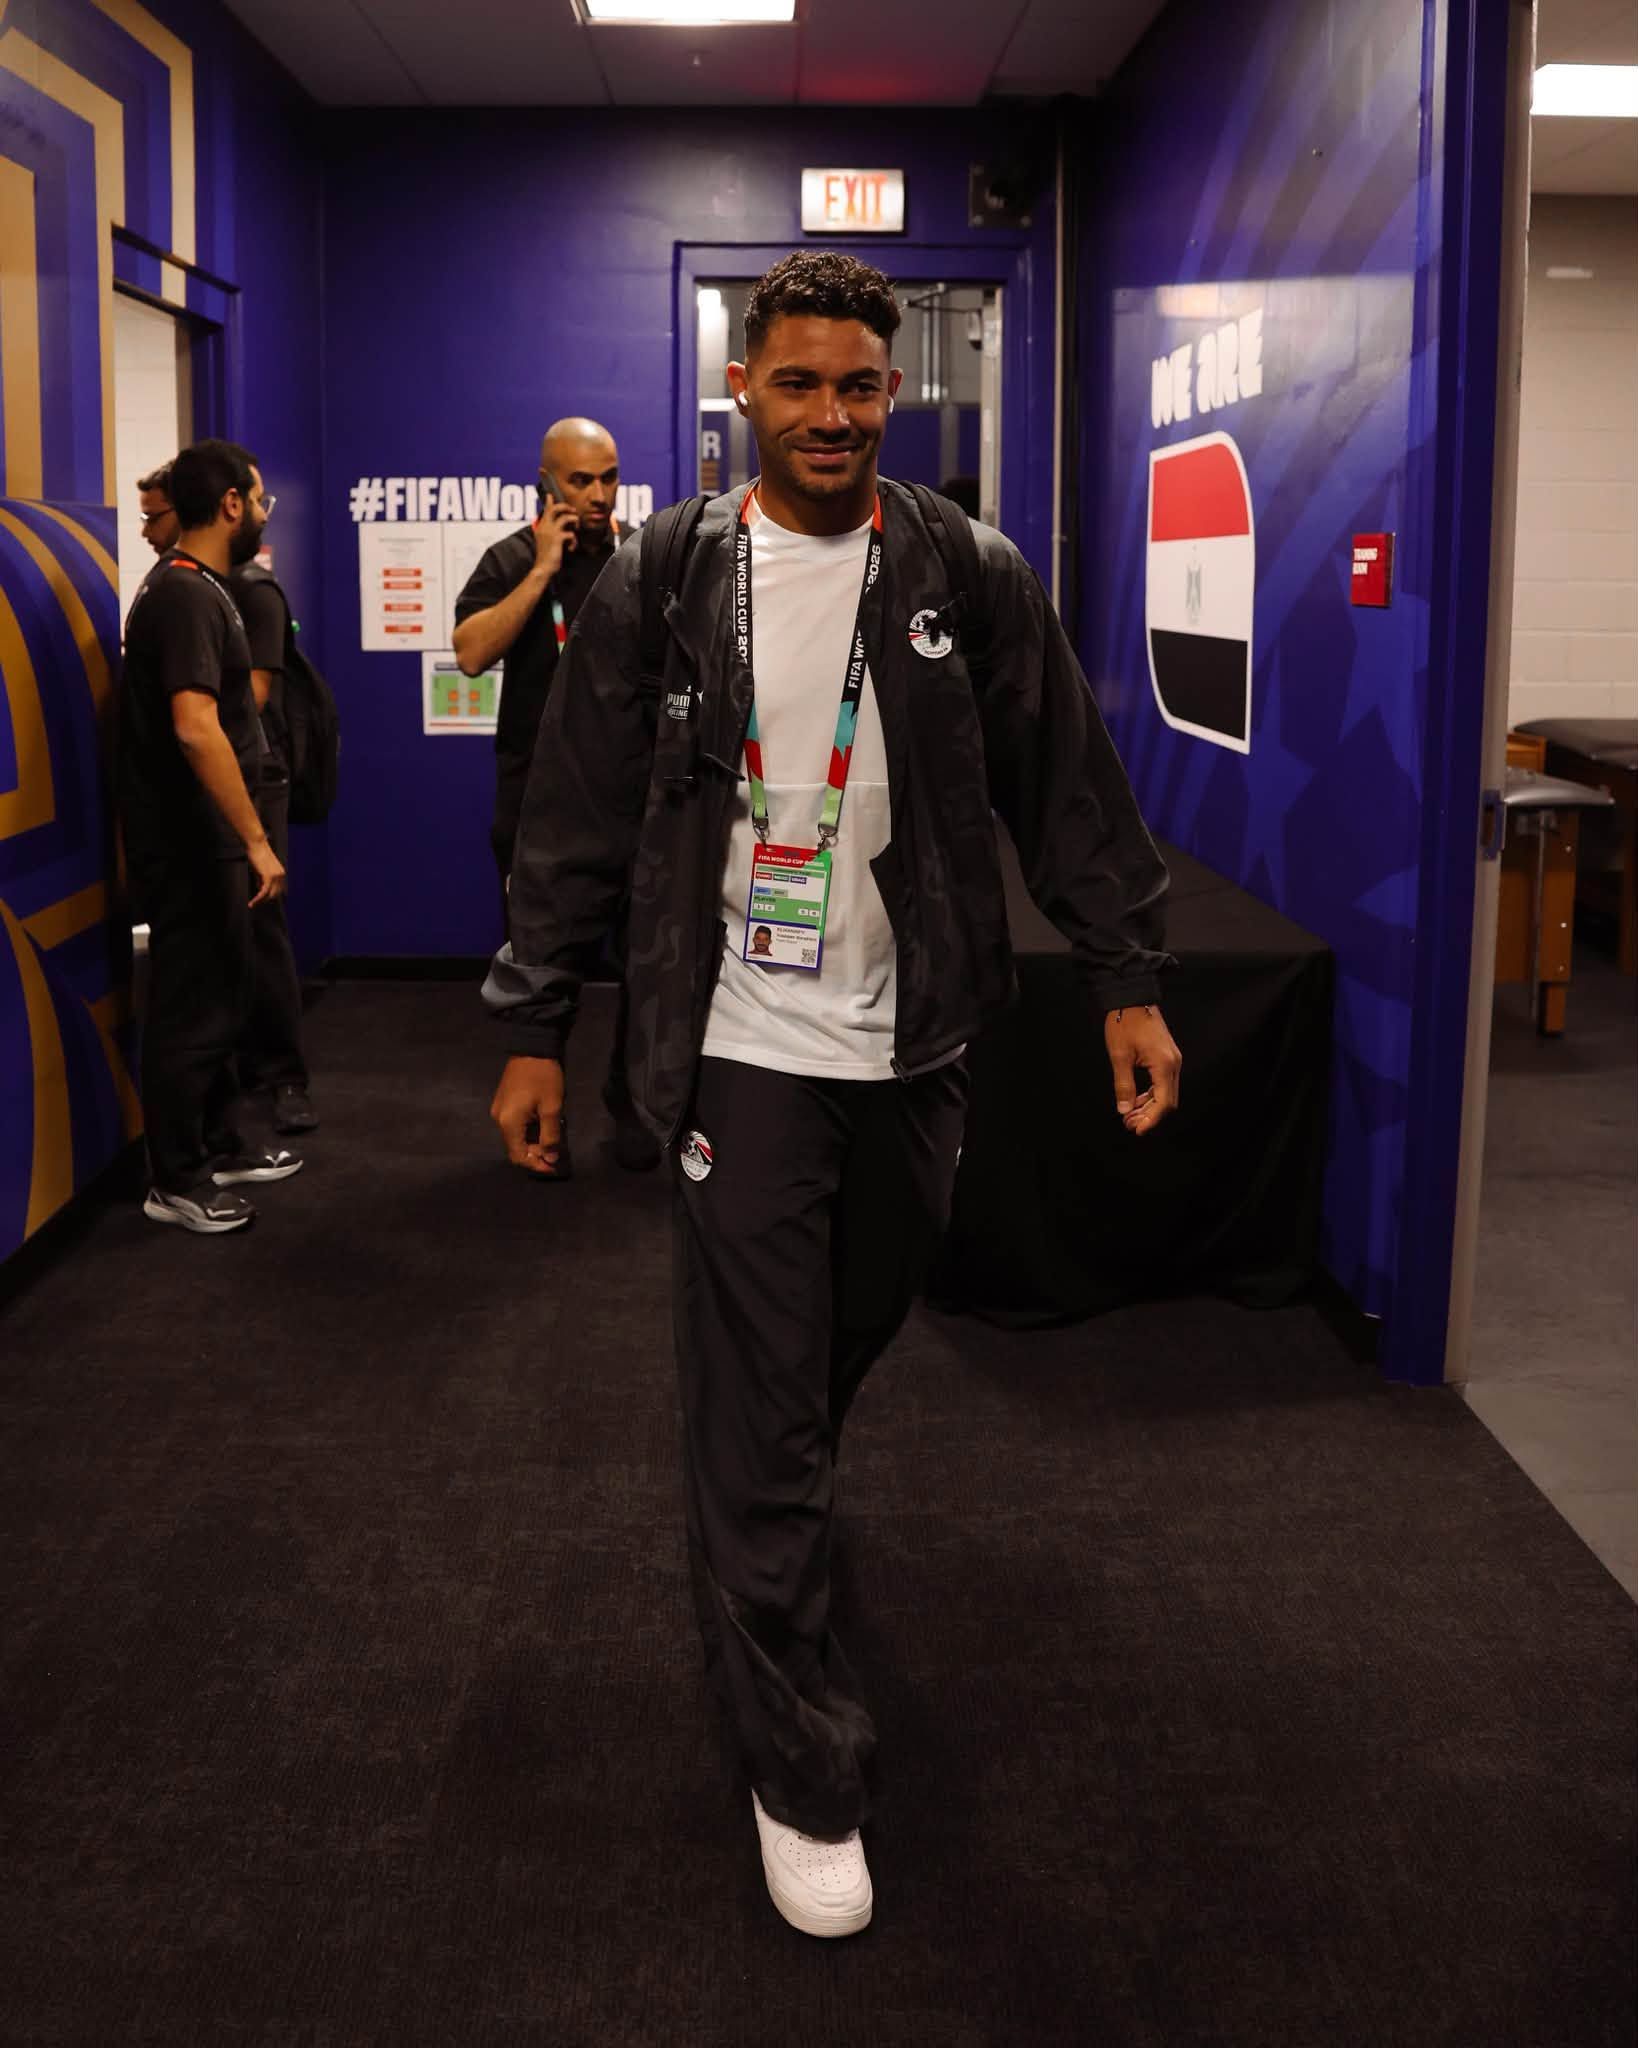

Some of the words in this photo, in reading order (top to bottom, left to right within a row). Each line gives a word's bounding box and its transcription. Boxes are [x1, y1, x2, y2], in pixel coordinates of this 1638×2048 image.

[825, 175, 888, 224] EXIT
[1151, 343, 1192, 429] WE
[349, 476, 653, 528] #FIFAWorup
[737, 534, 748, 560] FIFA
[737, 561, 747, 606] WORLD
[737, 608, 748, 633] CUP
[848, 661, 863, 689] FIFA
[867, 543, 881, 585] 2026
[667, 693, 691, 707] PUM
[771, 856, 792, 864] WORLD
